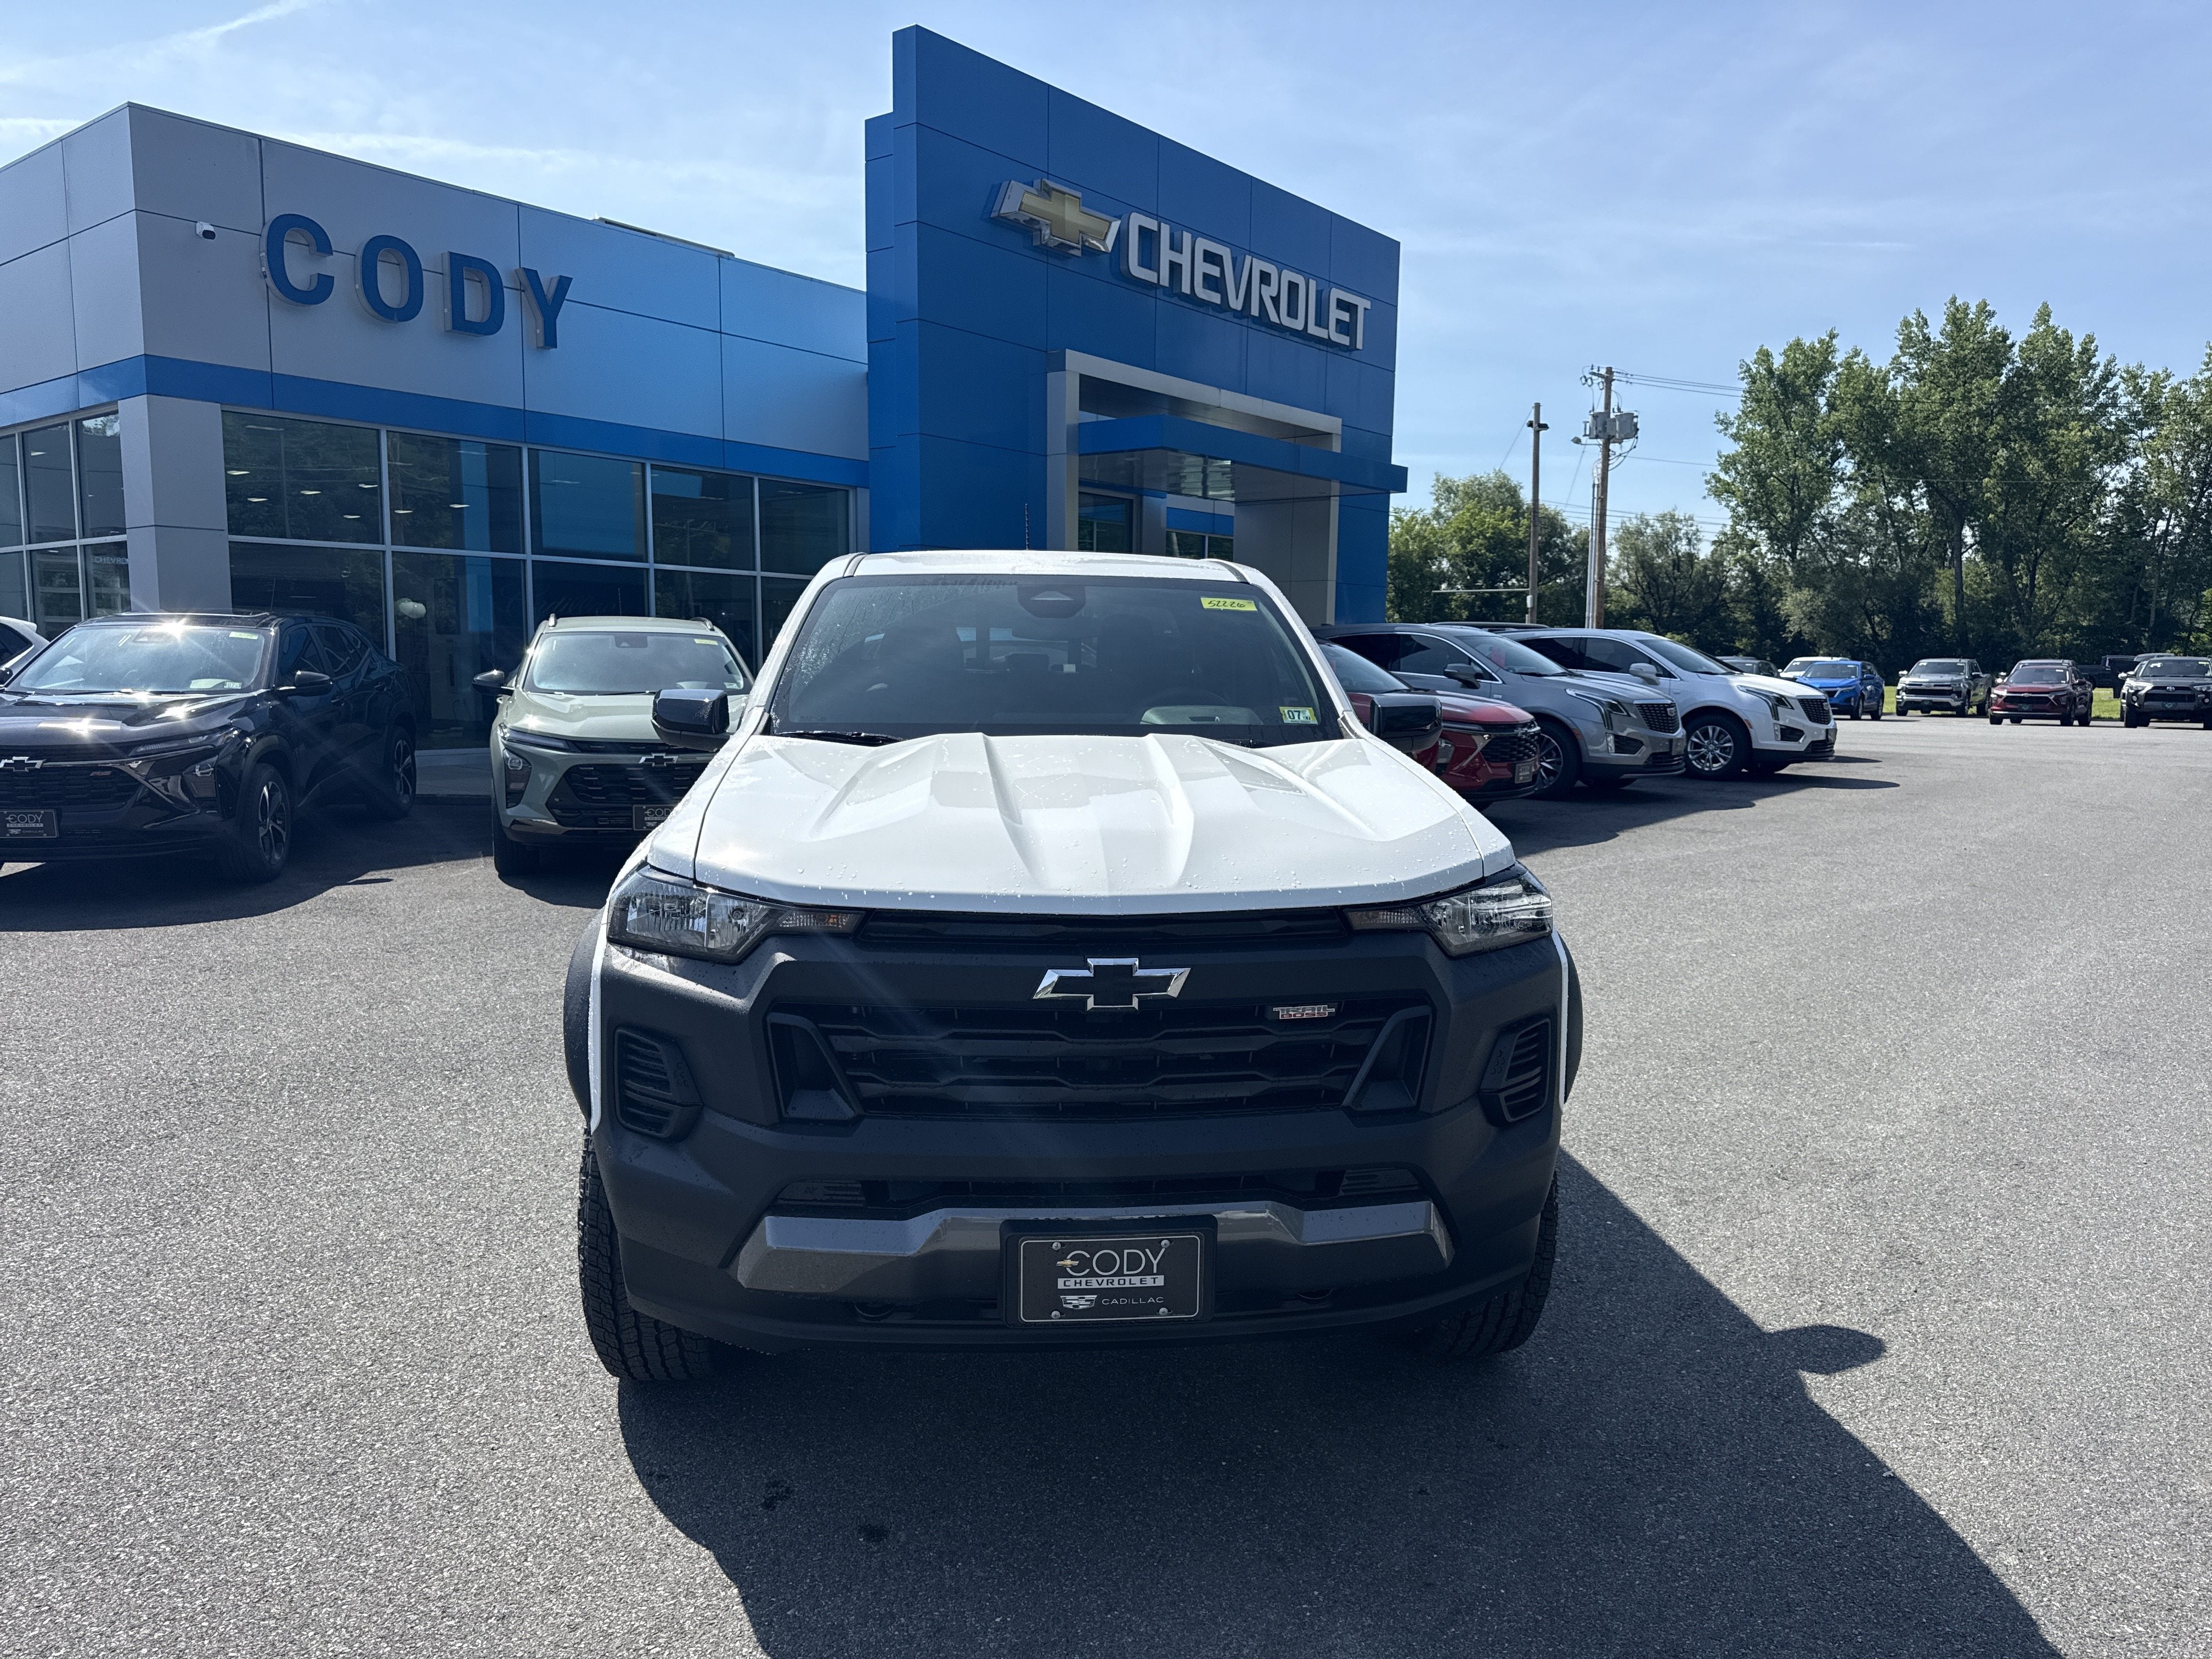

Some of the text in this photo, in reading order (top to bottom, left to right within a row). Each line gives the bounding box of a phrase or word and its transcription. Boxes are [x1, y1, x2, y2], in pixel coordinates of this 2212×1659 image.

[260, 213, 573, 348] CODY
[1121, 212, 1370, 350] CHEVROLET
[1287, 710, 1301, 719] 07
[8, 814, 42, 823] CODY
[1273, 1005, 1335, 1014] TRAIL
[1065, 1248, 1165, 1276] CODY
[1063, 1277, 1159, 1287] CHEVROLET
[1102, 1296, 1164, 1305] CADILLAC
